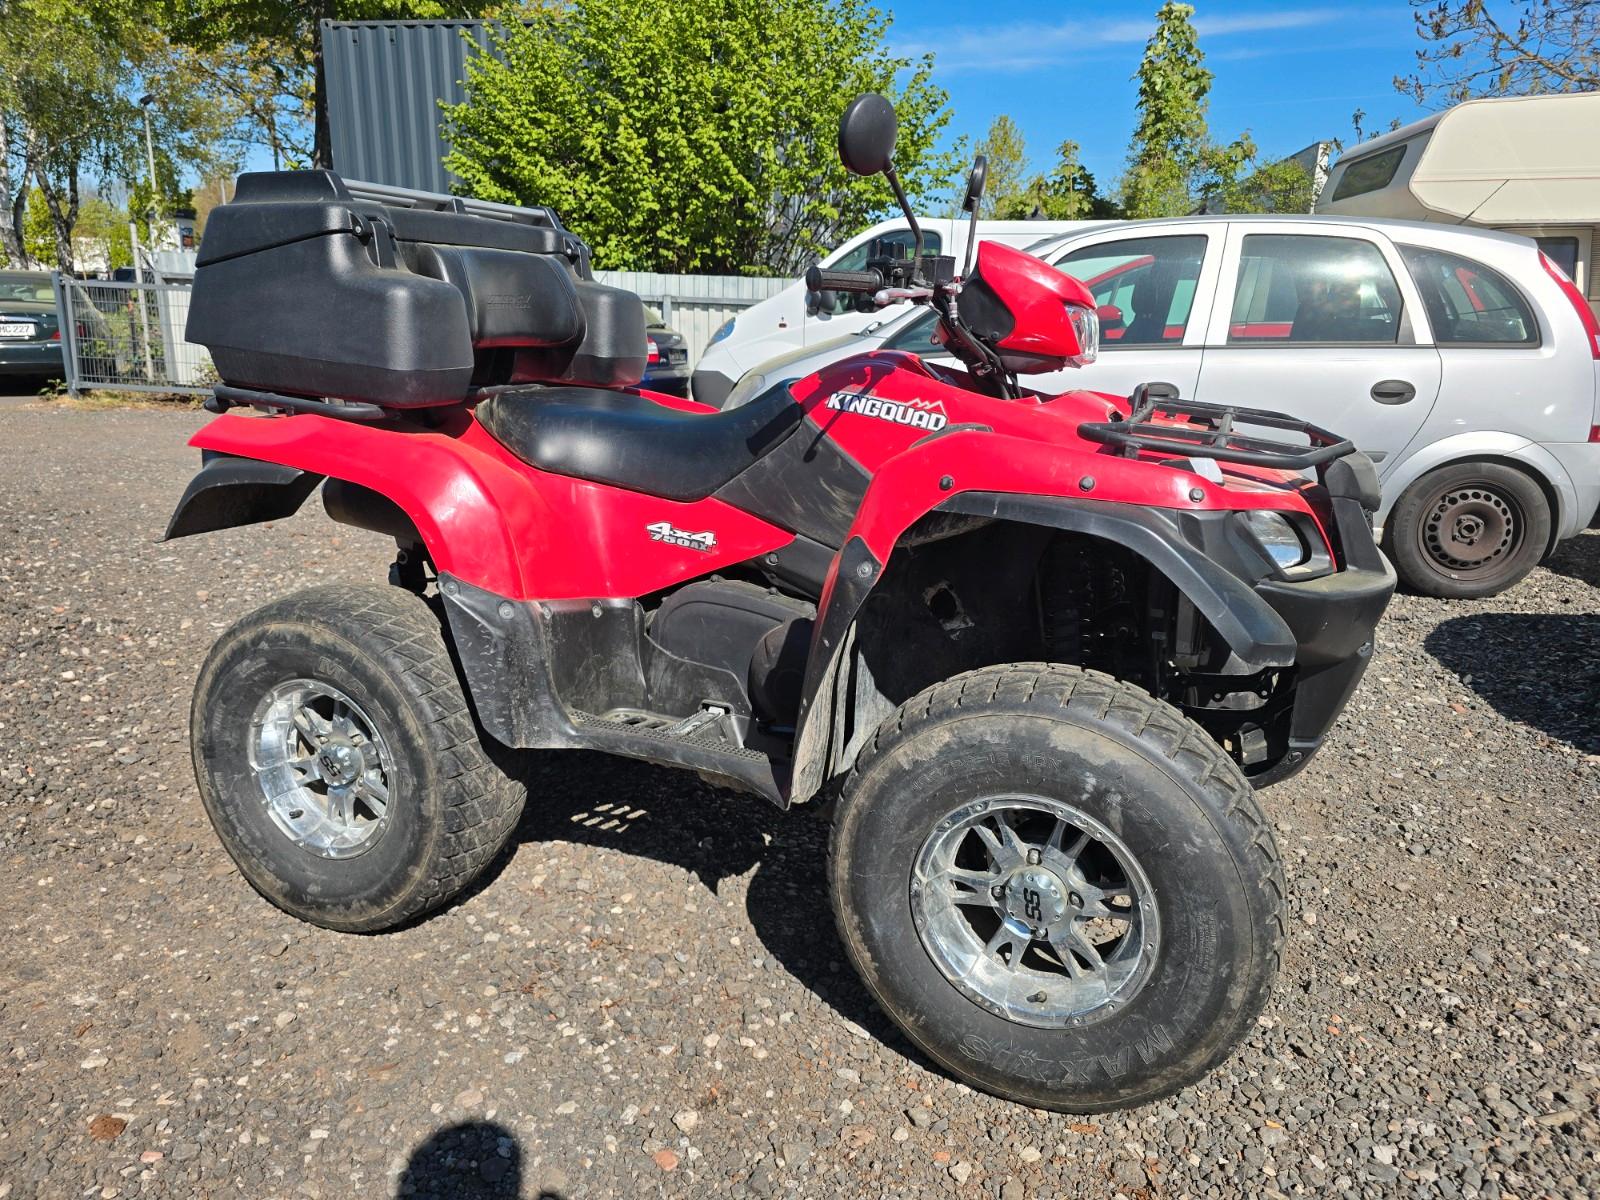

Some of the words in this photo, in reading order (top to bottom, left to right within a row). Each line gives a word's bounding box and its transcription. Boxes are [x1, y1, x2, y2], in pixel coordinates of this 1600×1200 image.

[13, 325, 29, 333] 227
[827, 393, 947, 431] KINGQUAD
[645, 521, 717, 546] 4x4
[1023, 887, 1042, 922] SS
